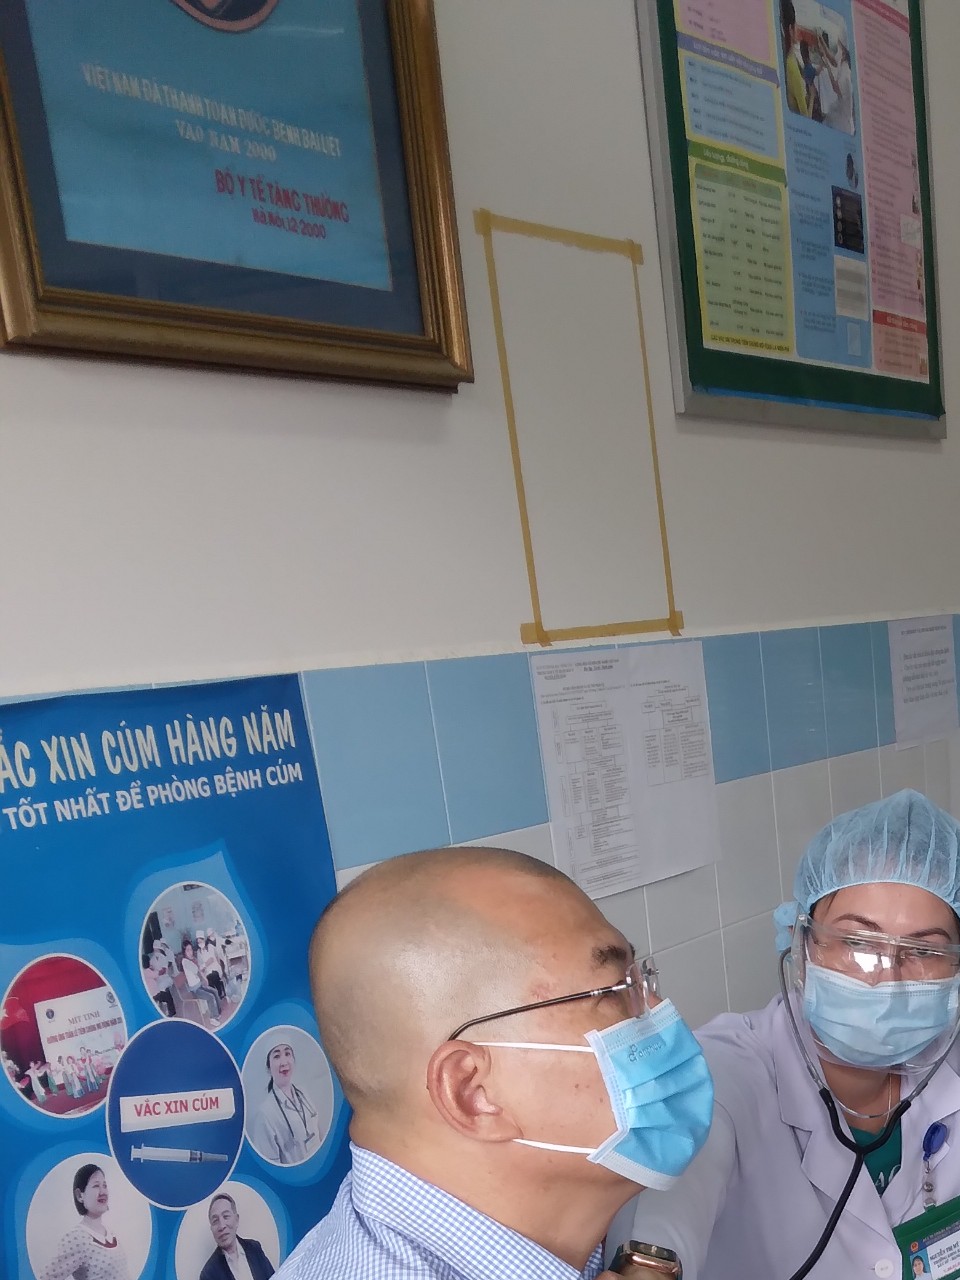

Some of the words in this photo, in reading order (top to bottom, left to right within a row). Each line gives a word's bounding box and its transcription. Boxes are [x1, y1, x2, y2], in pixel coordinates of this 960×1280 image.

[246, 140, 277, 162] 2000
[237, 174, 245, 197] Y
[0, 727, 36, 793] ẮC
[41, 732, 96, 785] XIN
[102, 721, 162, 775] CÚM
[166, 714, 237, 766] HÀNG
[242, 705, 296, 755] NĂM
[2, 797, 48, 830] TỐT
[54, 787, 110, 823] NHẤT
[116, 781, 145, 813] ĐỂ
[146, 774, 210, 807] PHÒNG
[215, 767, 262, 798] BỆNH
[266, 759, 303, 786] CÚM
[134, 1098, 160, 1117] VẮC
[164, 1100, 188, 1114] XIN
[192, 1093, 219, 1111] CÚM
